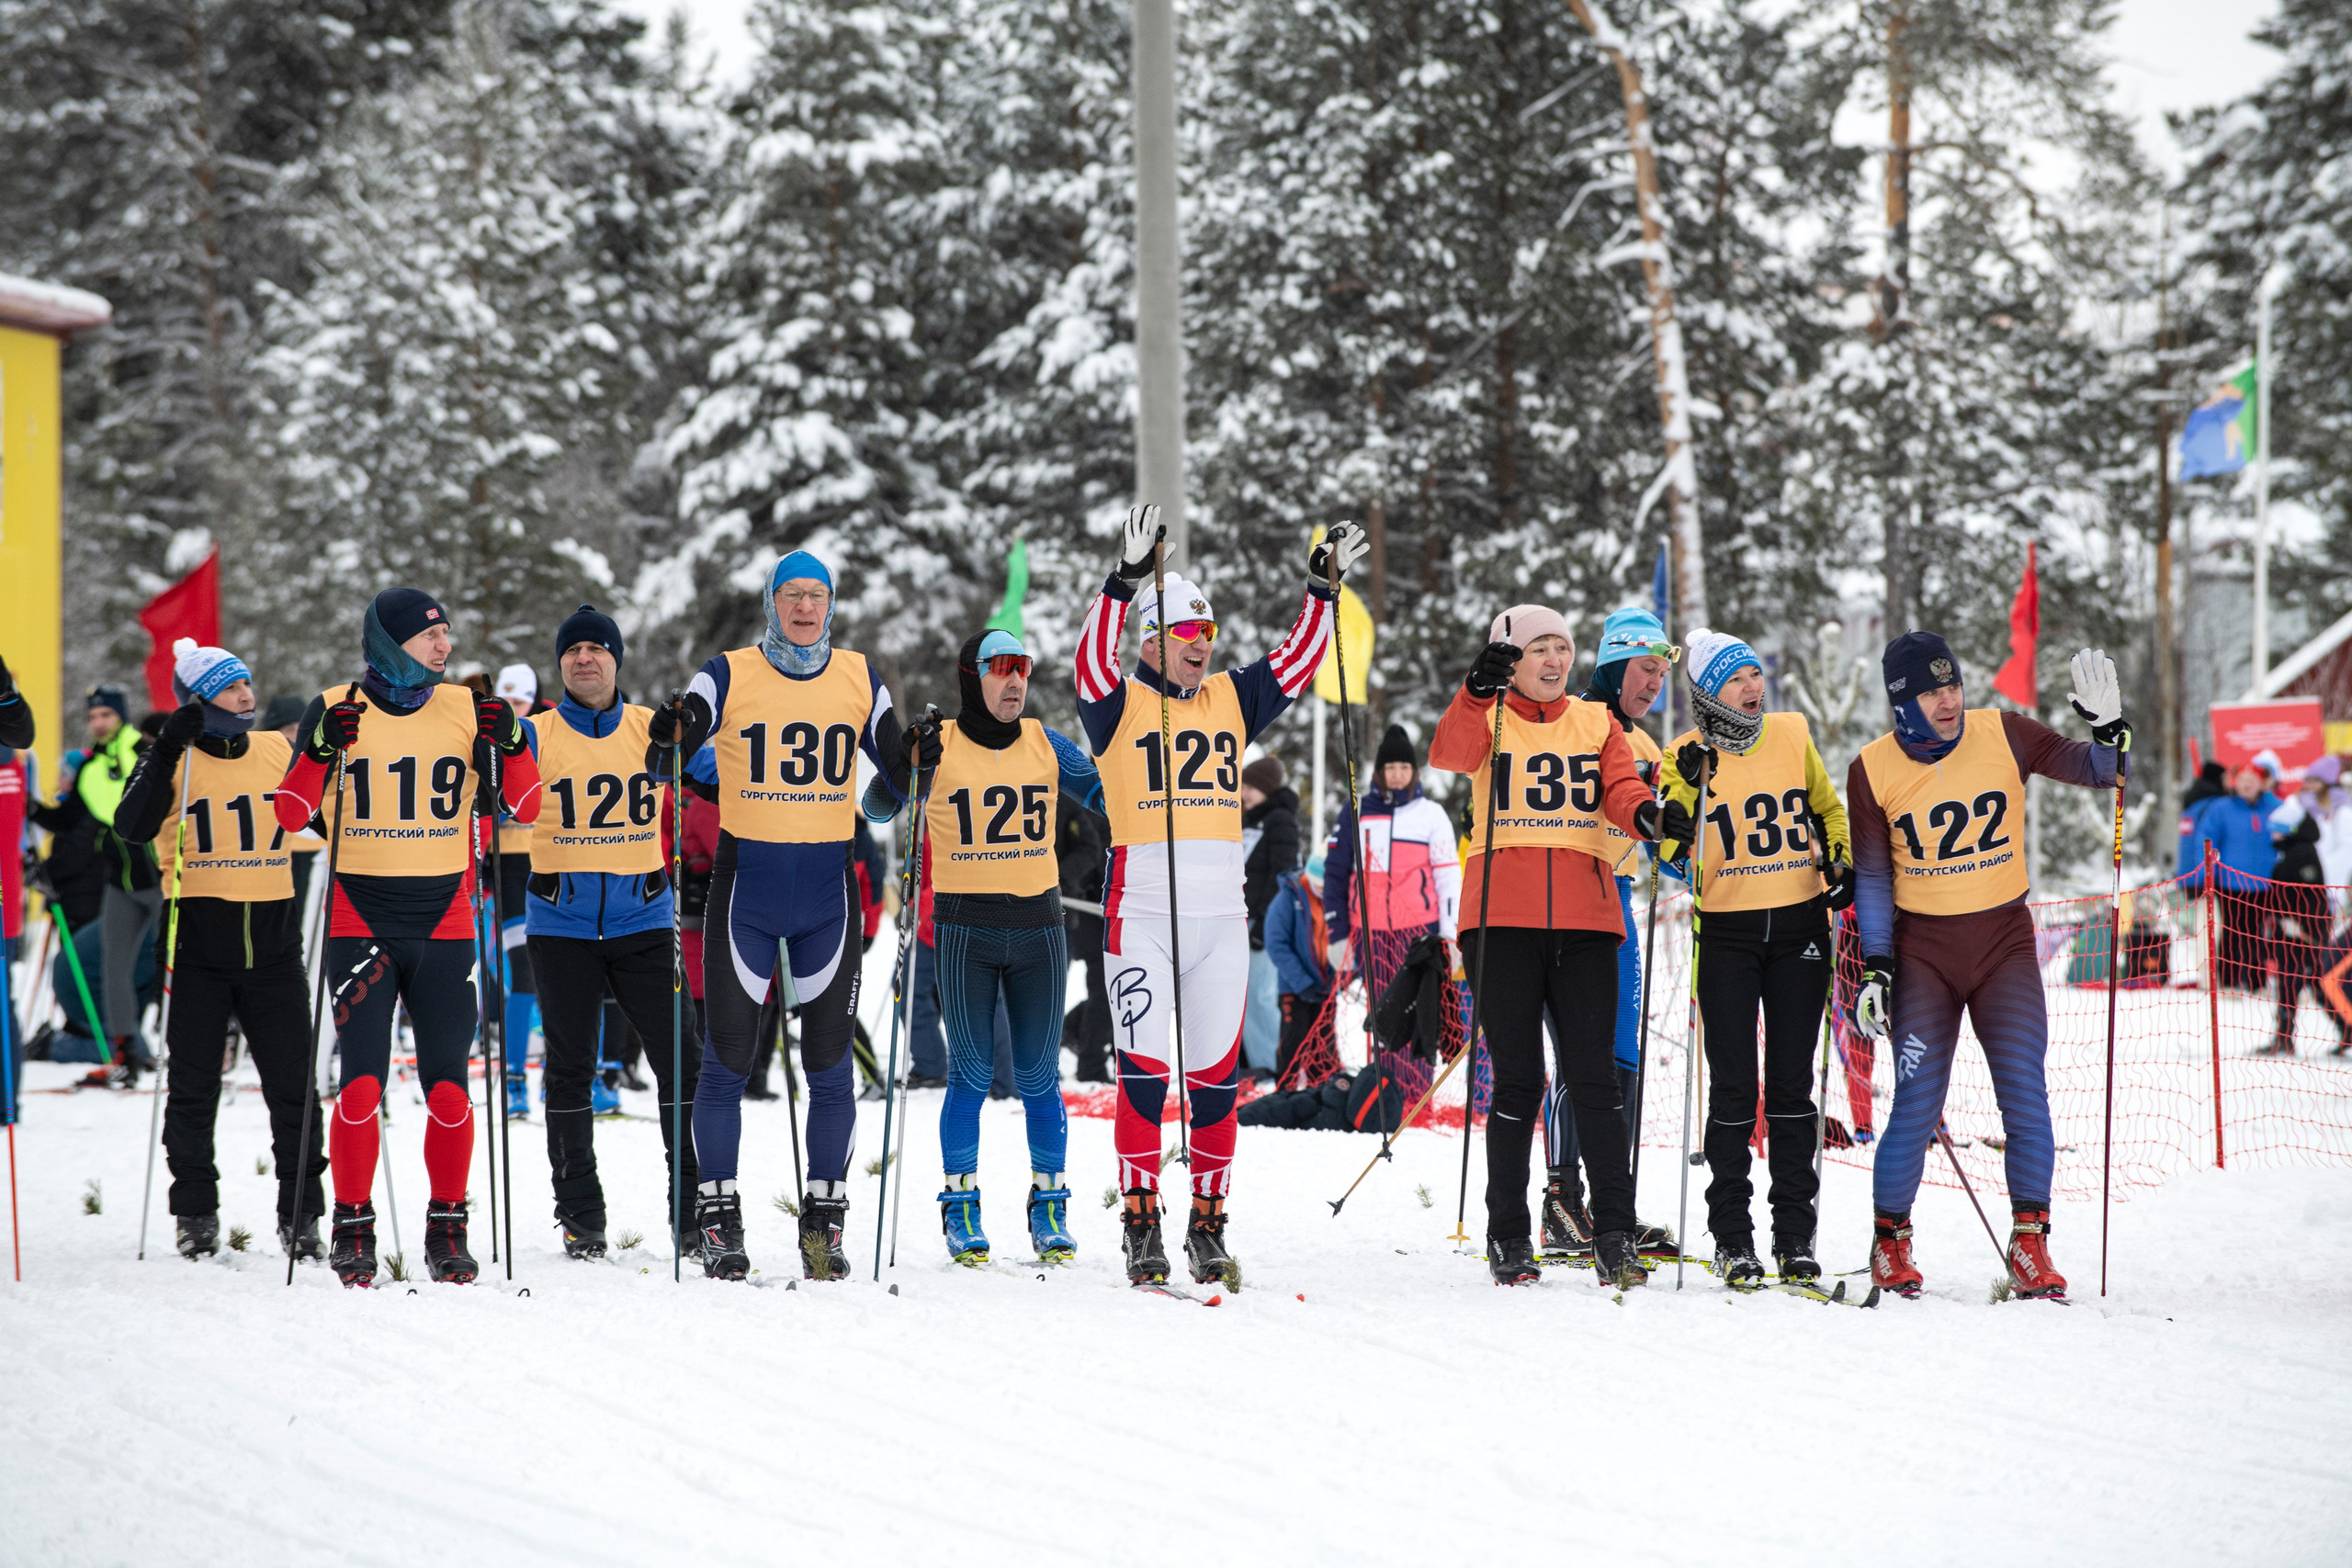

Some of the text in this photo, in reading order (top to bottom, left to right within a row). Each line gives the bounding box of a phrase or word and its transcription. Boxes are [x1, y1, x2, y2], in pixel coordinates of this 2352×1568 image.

[338, 749, 348, 791] MADSHUS
[740, 721, 856, 787] 130
[1135, 728, 1238, 793] 123
[345, 755, 467, 820] 119
[549, 772, 658, 829] 126
[741, 790, 815, 802] СУРГУТСКИЙ
[1490, 751, 1602, 814] 135
[345, 826, 458, 839] СУРГУТСКИЙ РАЙОН
[947, 784, 1049, 846] 125
[1494, 817, 1599, 829] УРГУТСКИЙ РАЙОН
[1705, 787, 1811, 862] 133
[1893, 790, 2009, 862] 122
[553, 830, 655, 845] СУРГУТСКИЙ РАЙОН
[951, 847, 1047, 862] СУРГУТСКИЙ РАЙОН
[187, 857, 262, 869] СУРГУТСКИЙ
[1787, 857, 1813, 871] РАЙО
[1905, 851, 2013, 876] СУРГУТСКИЙ РАЙОН
[847, 980, 858, 1015] CRAFT
[1551, 1200, 1581, 1244] ROSSIGNOL
[1538, 1258, 1592, 1269] FISCHER
